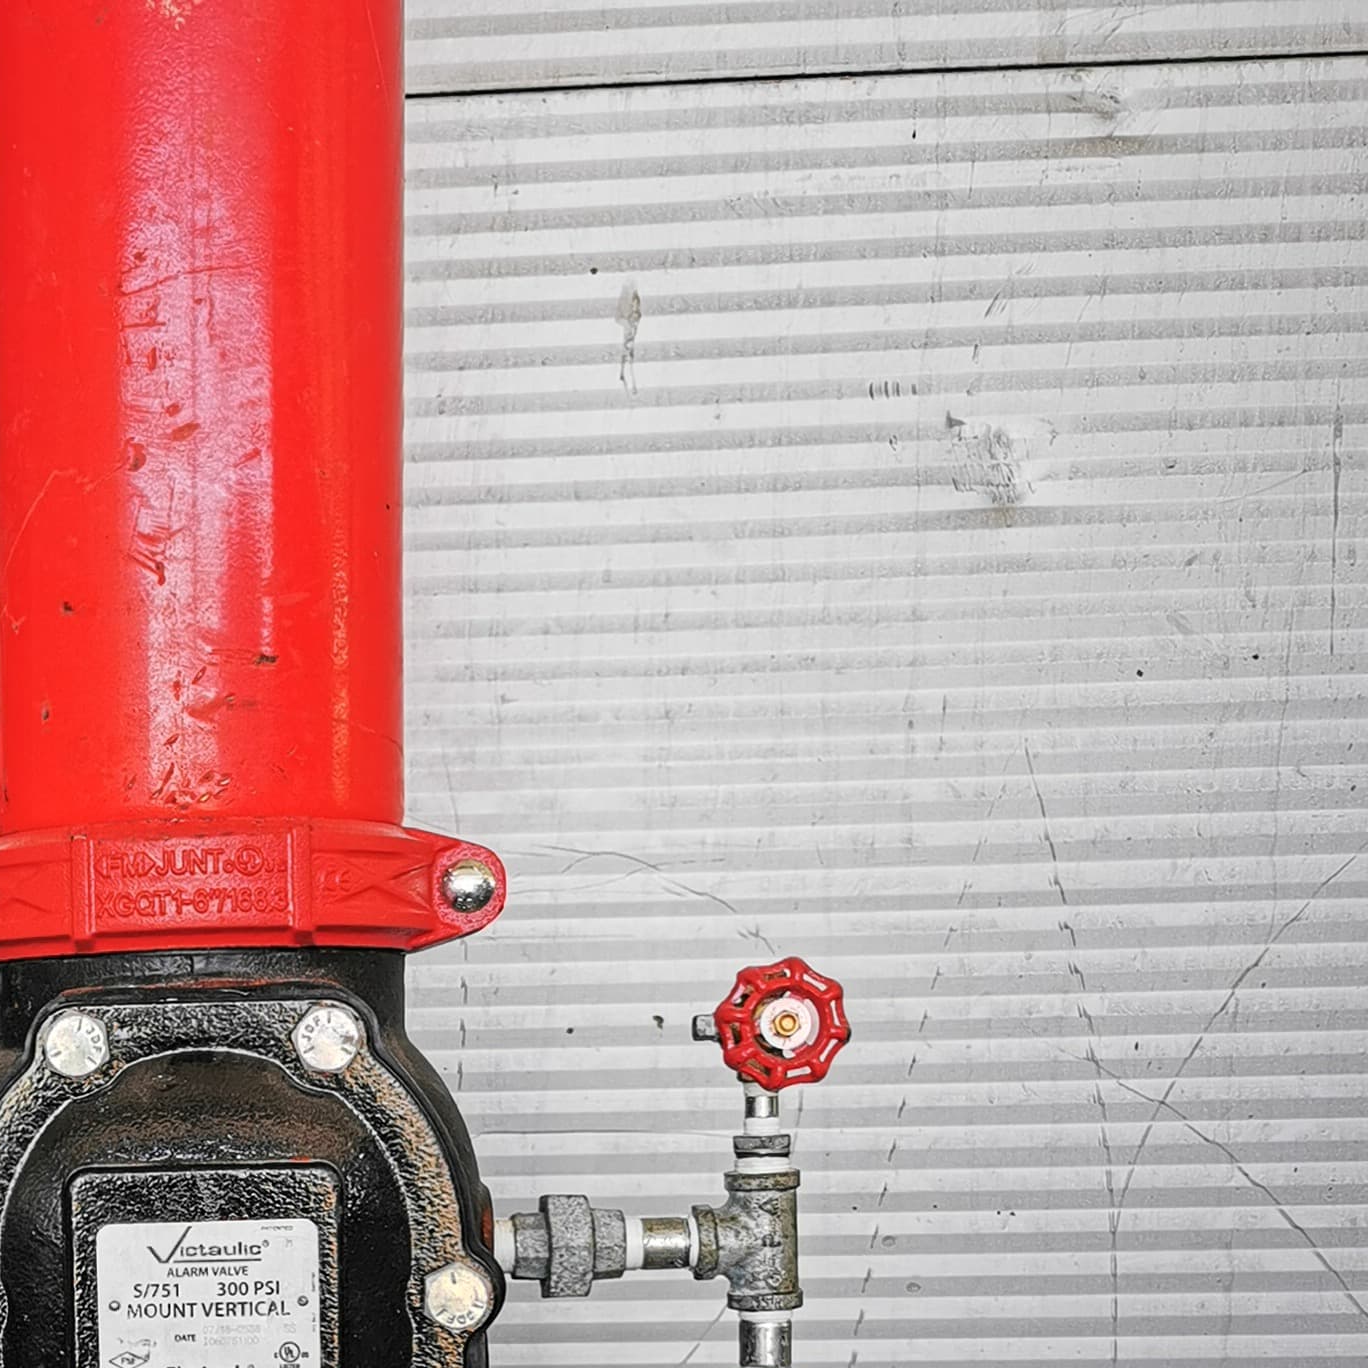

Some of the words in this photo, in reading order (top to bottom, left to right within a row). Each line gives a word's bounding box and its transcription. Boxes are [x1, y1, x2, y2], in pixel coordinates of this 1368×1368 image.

[147, 1226, 263, 1263] Victaulic
[167, 1267, 209, 1278] ALARM
[212, 1266, 249, 1276] VALVE
[133, 1283, 181, 1298] S/751
[217, 1282, 249, 1296] 300
[254, 1281, 280, 1295] PSI
[127, 1303, 196, 1319] MOUNT
[201, 1300, 291, 1318] VERTICAL
[175, 1334, 197, 1342] DATE
